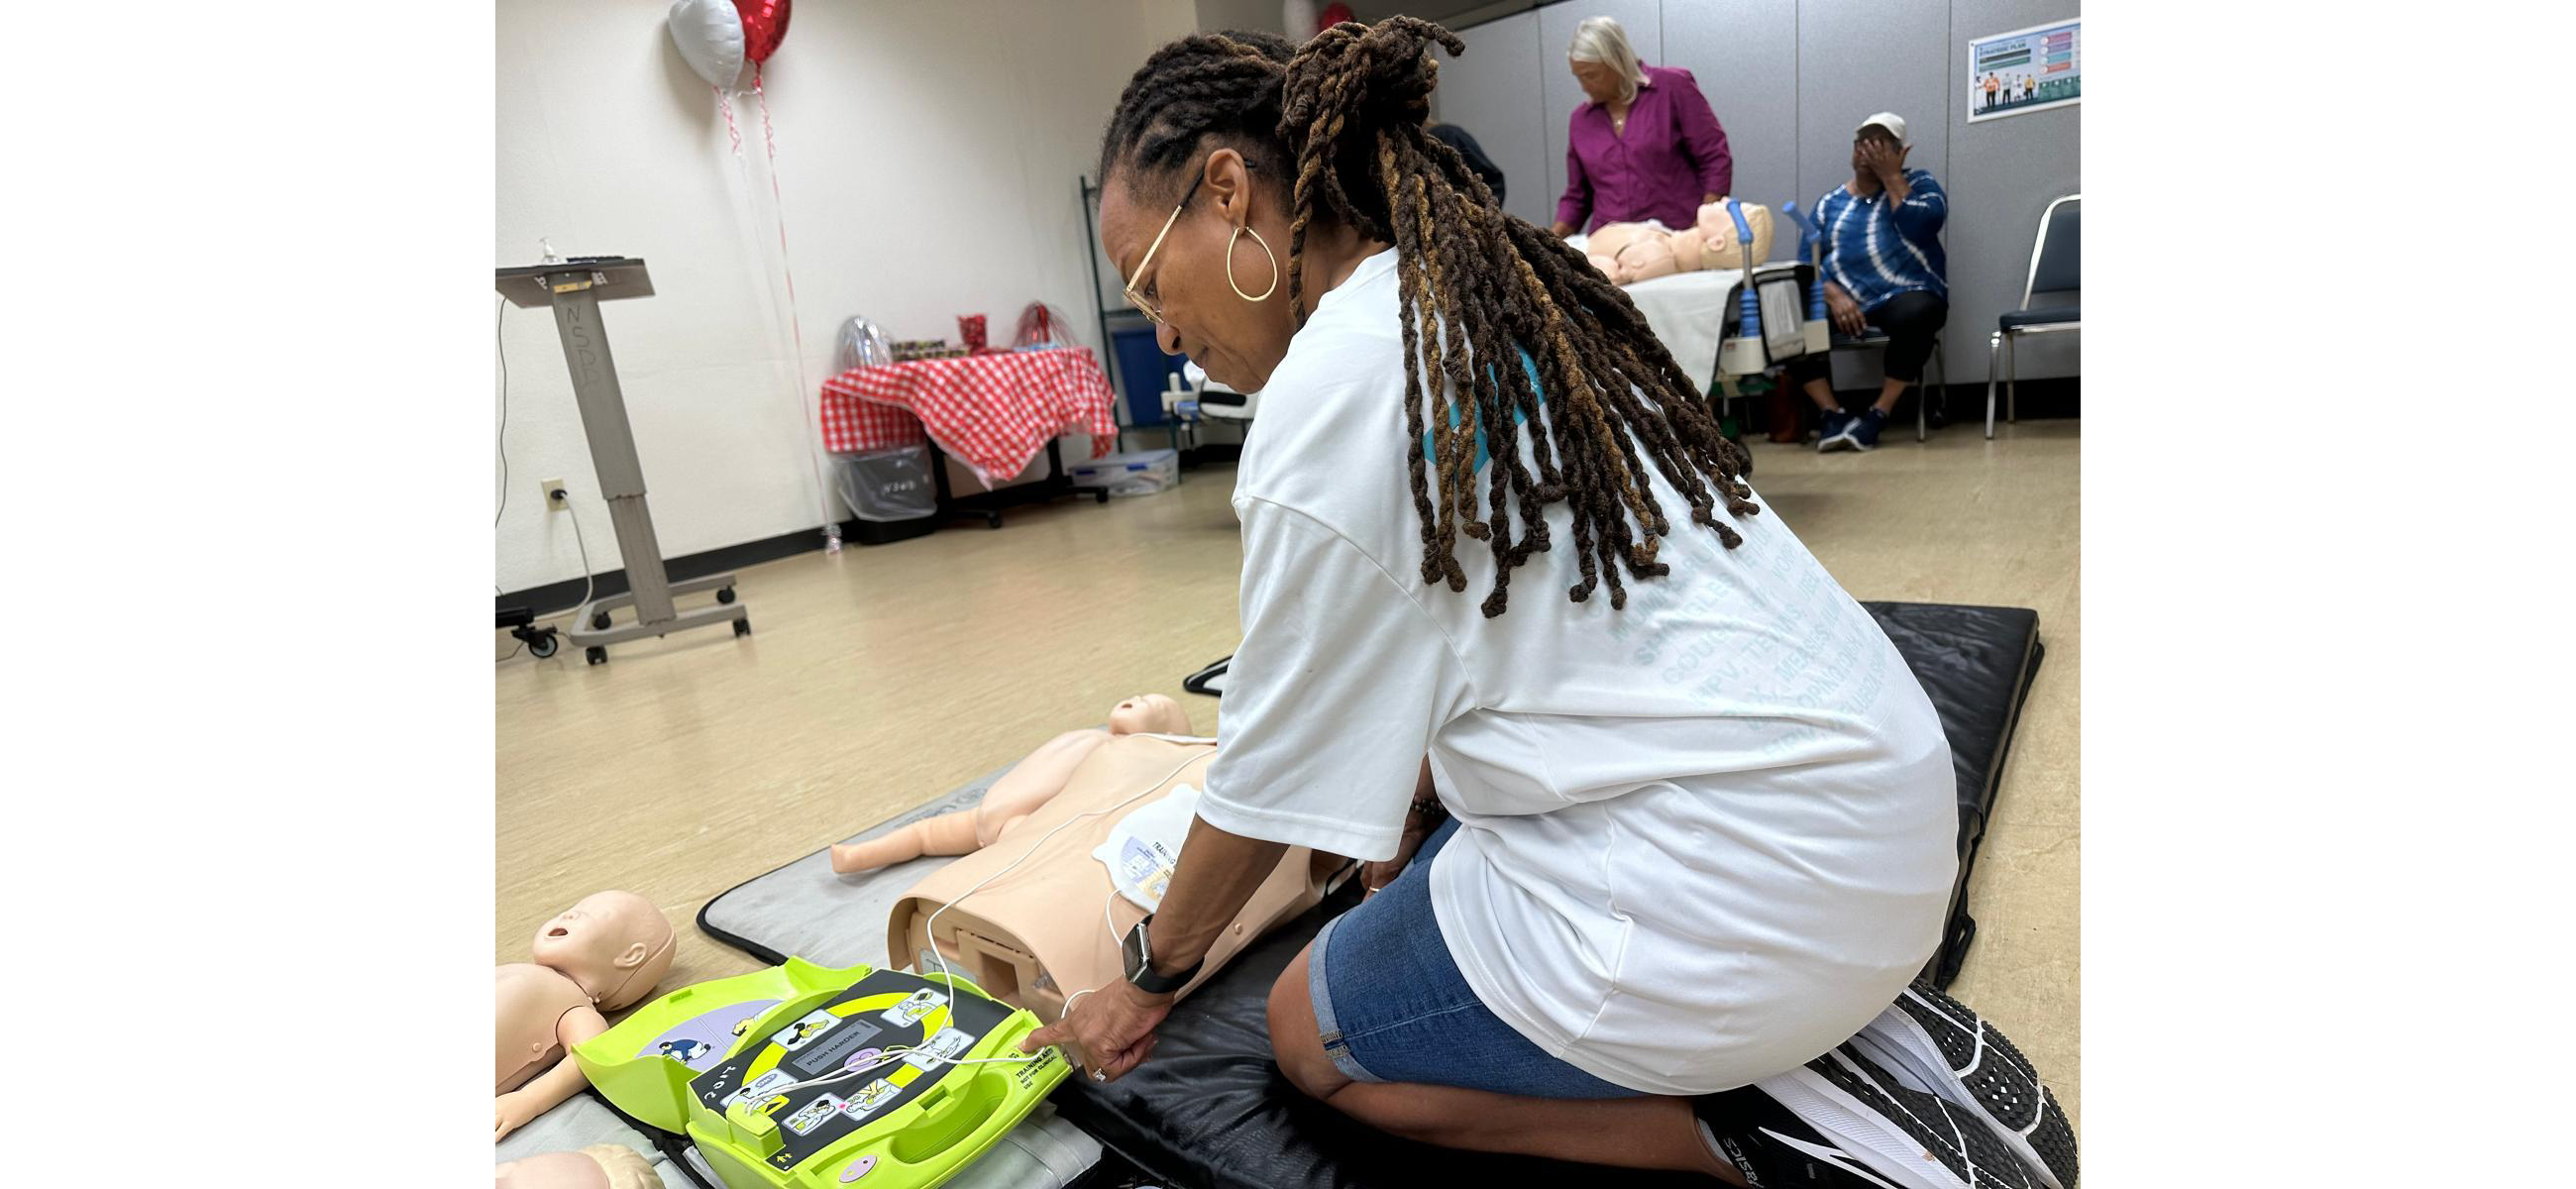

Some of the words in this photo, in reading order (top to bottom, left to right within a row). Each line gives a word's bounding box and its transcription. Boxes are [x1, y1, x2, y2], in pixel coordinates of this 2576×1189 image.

[806, 1051, 829, 1066] PUSH
[829, 1031, 861, 1052] HARDER
[1016, 1057, 1042, 1078] TRAINING
[1020, 1075, 1030, 1084] NOT
[1029, 1068, 1038, 1077] FOR
[1037, 1055, 1057, 1071] CLINICAL
[1023, 1081, 1033, 1090] USE
